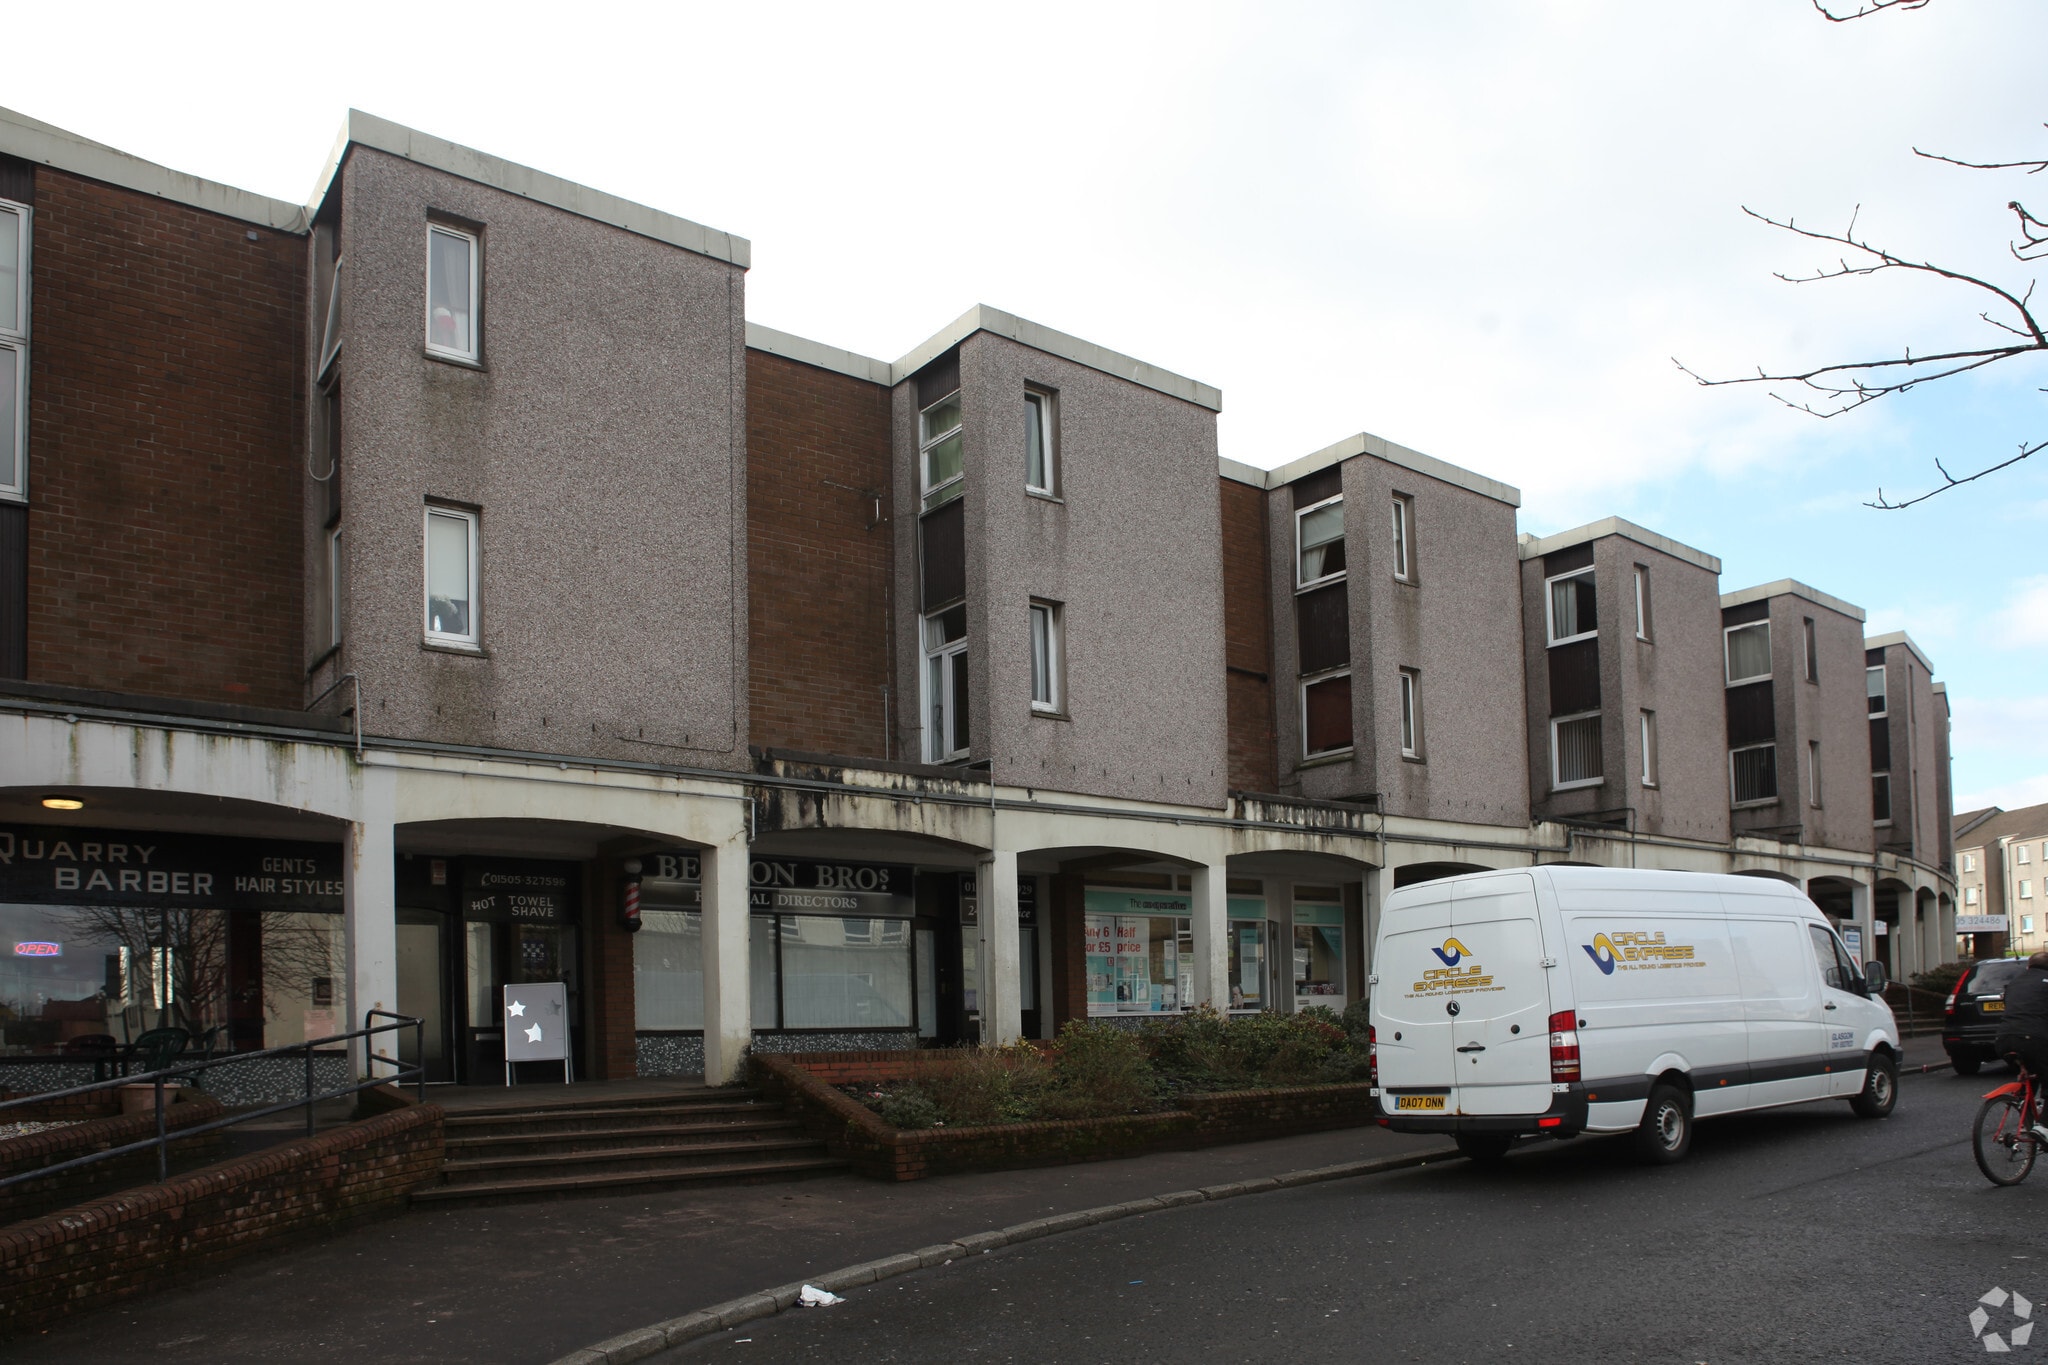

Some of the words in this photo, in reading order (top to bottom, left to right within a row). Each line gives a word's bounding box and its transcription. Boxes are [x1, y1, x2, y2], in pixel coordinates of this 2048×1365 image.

[262, 857, 316, 874] GENTS
[55, 867, 214, 896] BARBER
[235, 876, 276, 893] HAIR
[281, 879, 344, 896] STYLES
[471, 895, 496, 911] HOT
[508, 895, 554, 907] TOWEL
[777, 894, 858, 909] DIRECTORS
[1129, 898, 1142, 909] The
[511, 906, 554, 918] SHAVE
[1103, 926, 1110, 938] 6
[1117, 926, 1136, 938] Half
[1611, 931, 1667, 946] CIRCLE
[15, 943, 59, 955] OPEN
[1085, 942, 1096, 953] or
[1098, 941, 1111, 953] £5
[1117, 941, 1141, 954] price
[1624, 945, 1695, 961] EXPRESS
[1423, 965, 1482, 980] CIRCLE
[1413, 975, 1494, 992] EXPRESS
[1445, 988, 1475, 996] LOGISTICS
[1400, 1097, 1423, 1108] DA07
